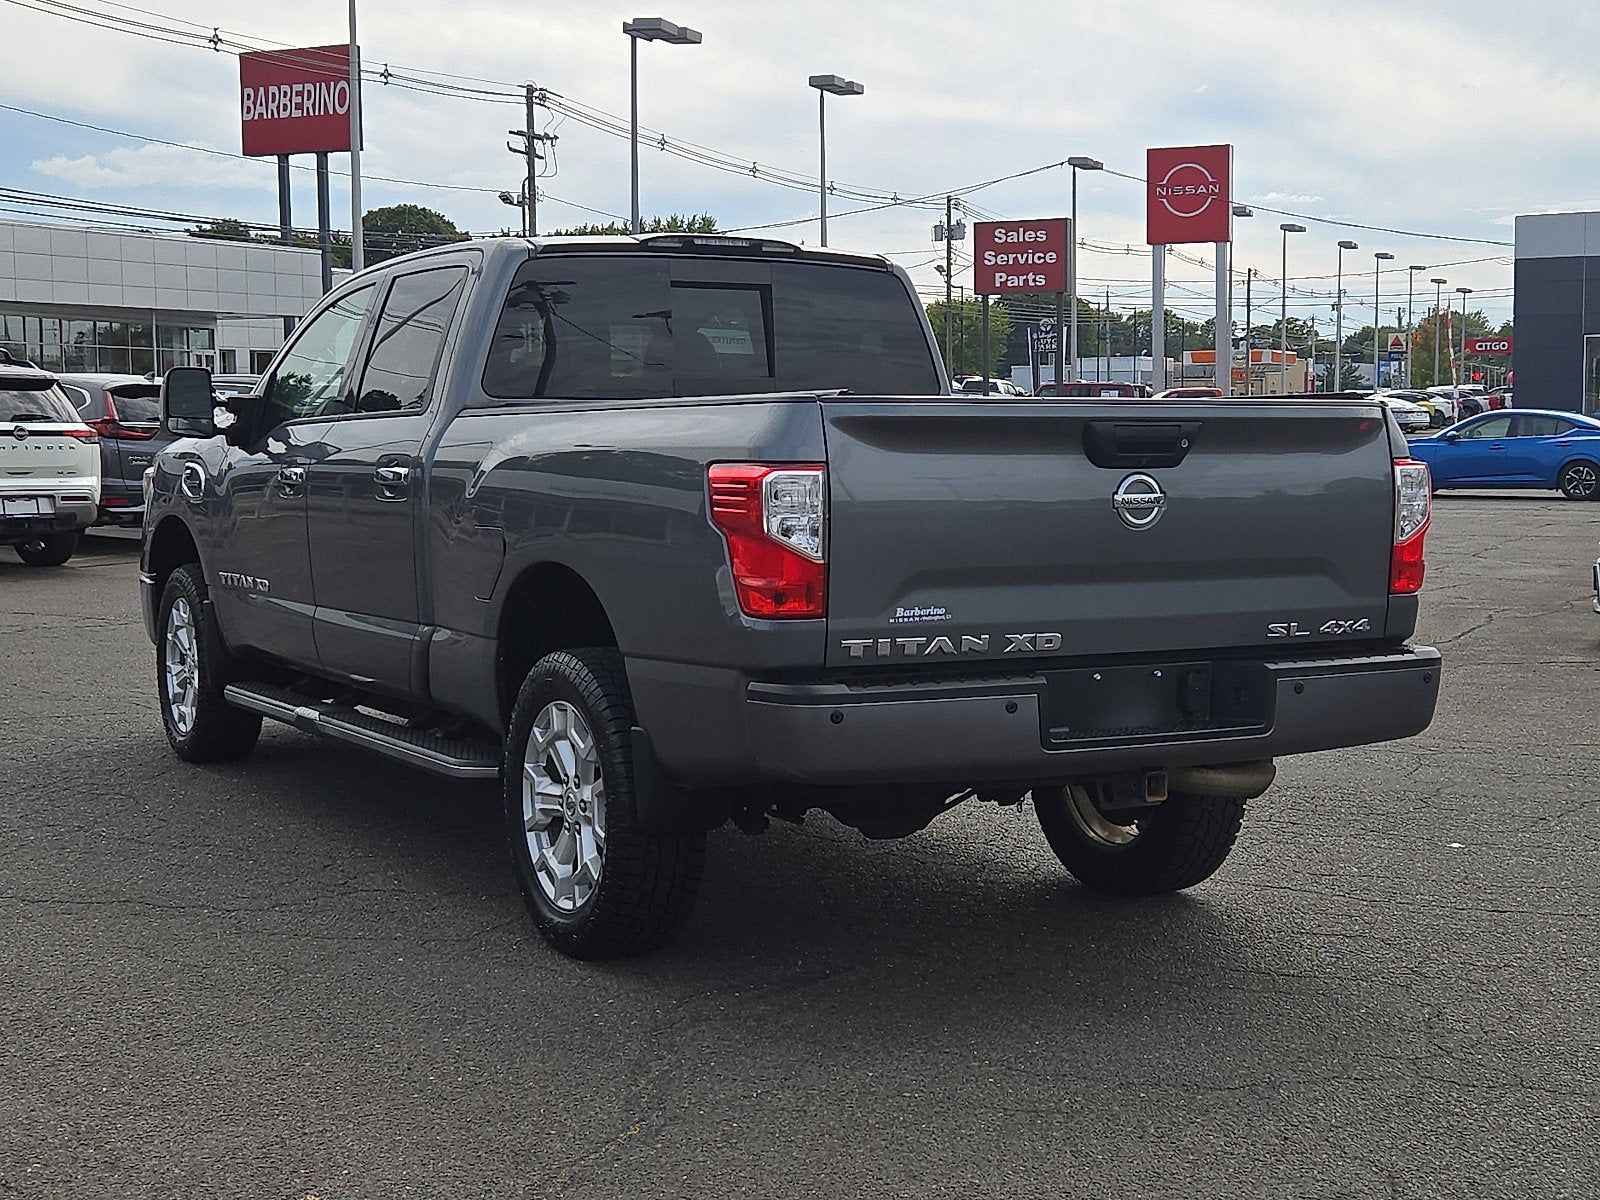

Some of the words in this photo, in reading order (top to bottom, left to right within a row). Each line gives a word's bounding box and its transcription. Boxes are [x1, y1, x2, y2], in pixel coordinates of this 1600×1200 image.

[242, 80, 350, 121] BARBERINO
[1156, 184, 1219, 196] NISSAN
[994, 227, 1047, 243] Sales
[983, 249, 1057, 266] Service
[994, 271, 1046, 287] Parts
[1475, 341, 1508, 351] CITGO
[1120, 496, 1161, 505] NISSAN
[218, 571, 254, 589] TITAN
[254, 577, 270, 592] XD
[895, 605, 946, 617] Barberino
[1267, 622, 1311, 637] SL
[840, 635, 990, 659] TITAN
[1003, 633, 1063, 653] XD
